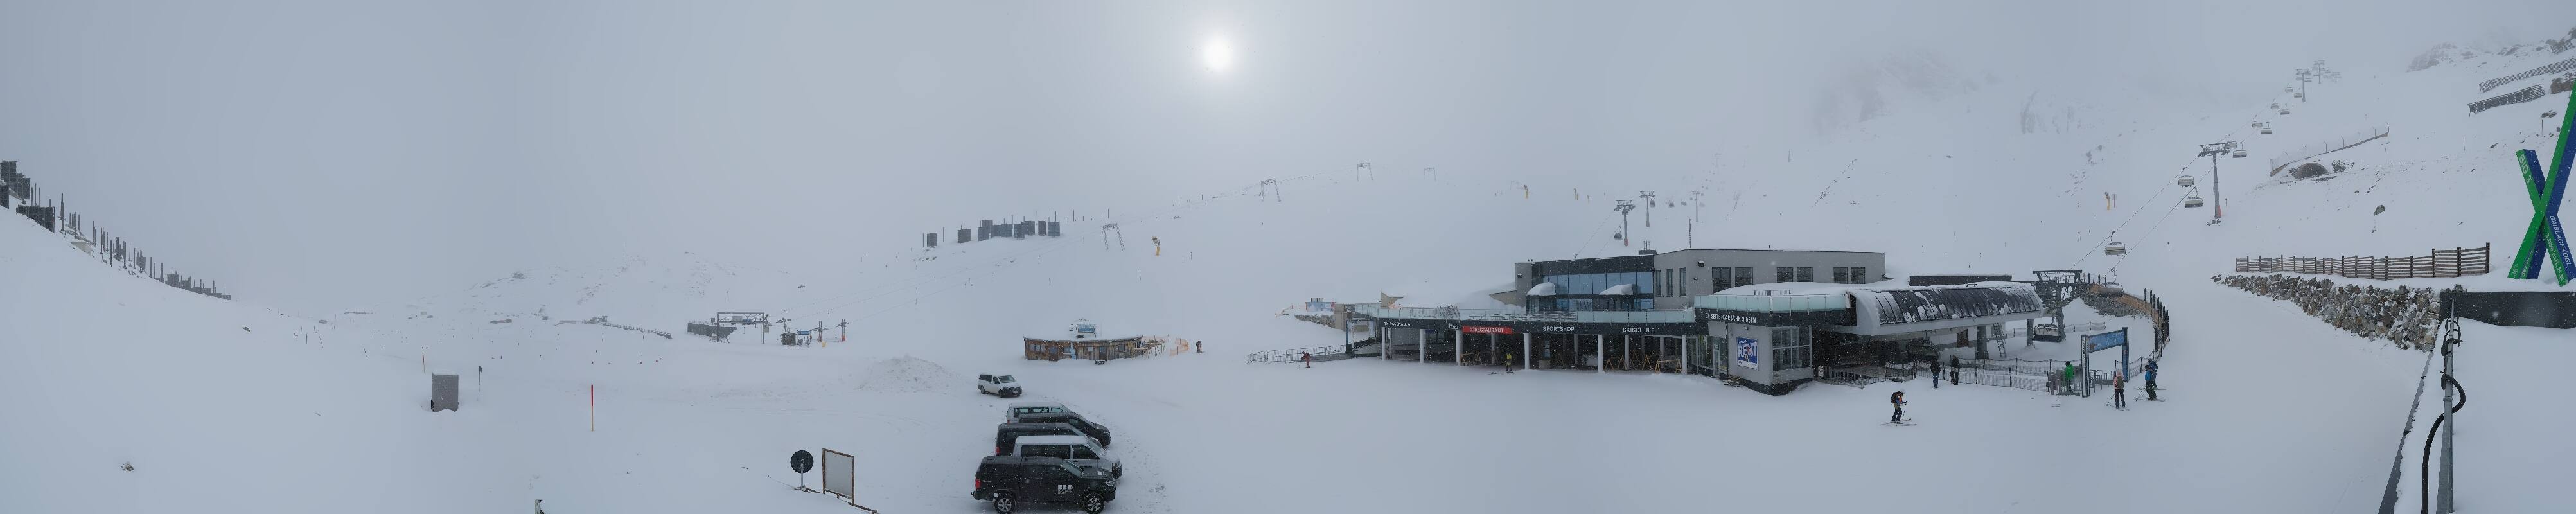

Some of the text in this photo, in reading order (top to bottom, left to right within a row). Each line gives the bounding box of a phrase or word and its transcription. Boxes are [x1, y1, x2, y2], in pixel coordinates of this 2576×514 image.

[2519, 154, 2532, 184] BIG 3
[2550, 215, 2572, 265] GAISLACHKOGL
